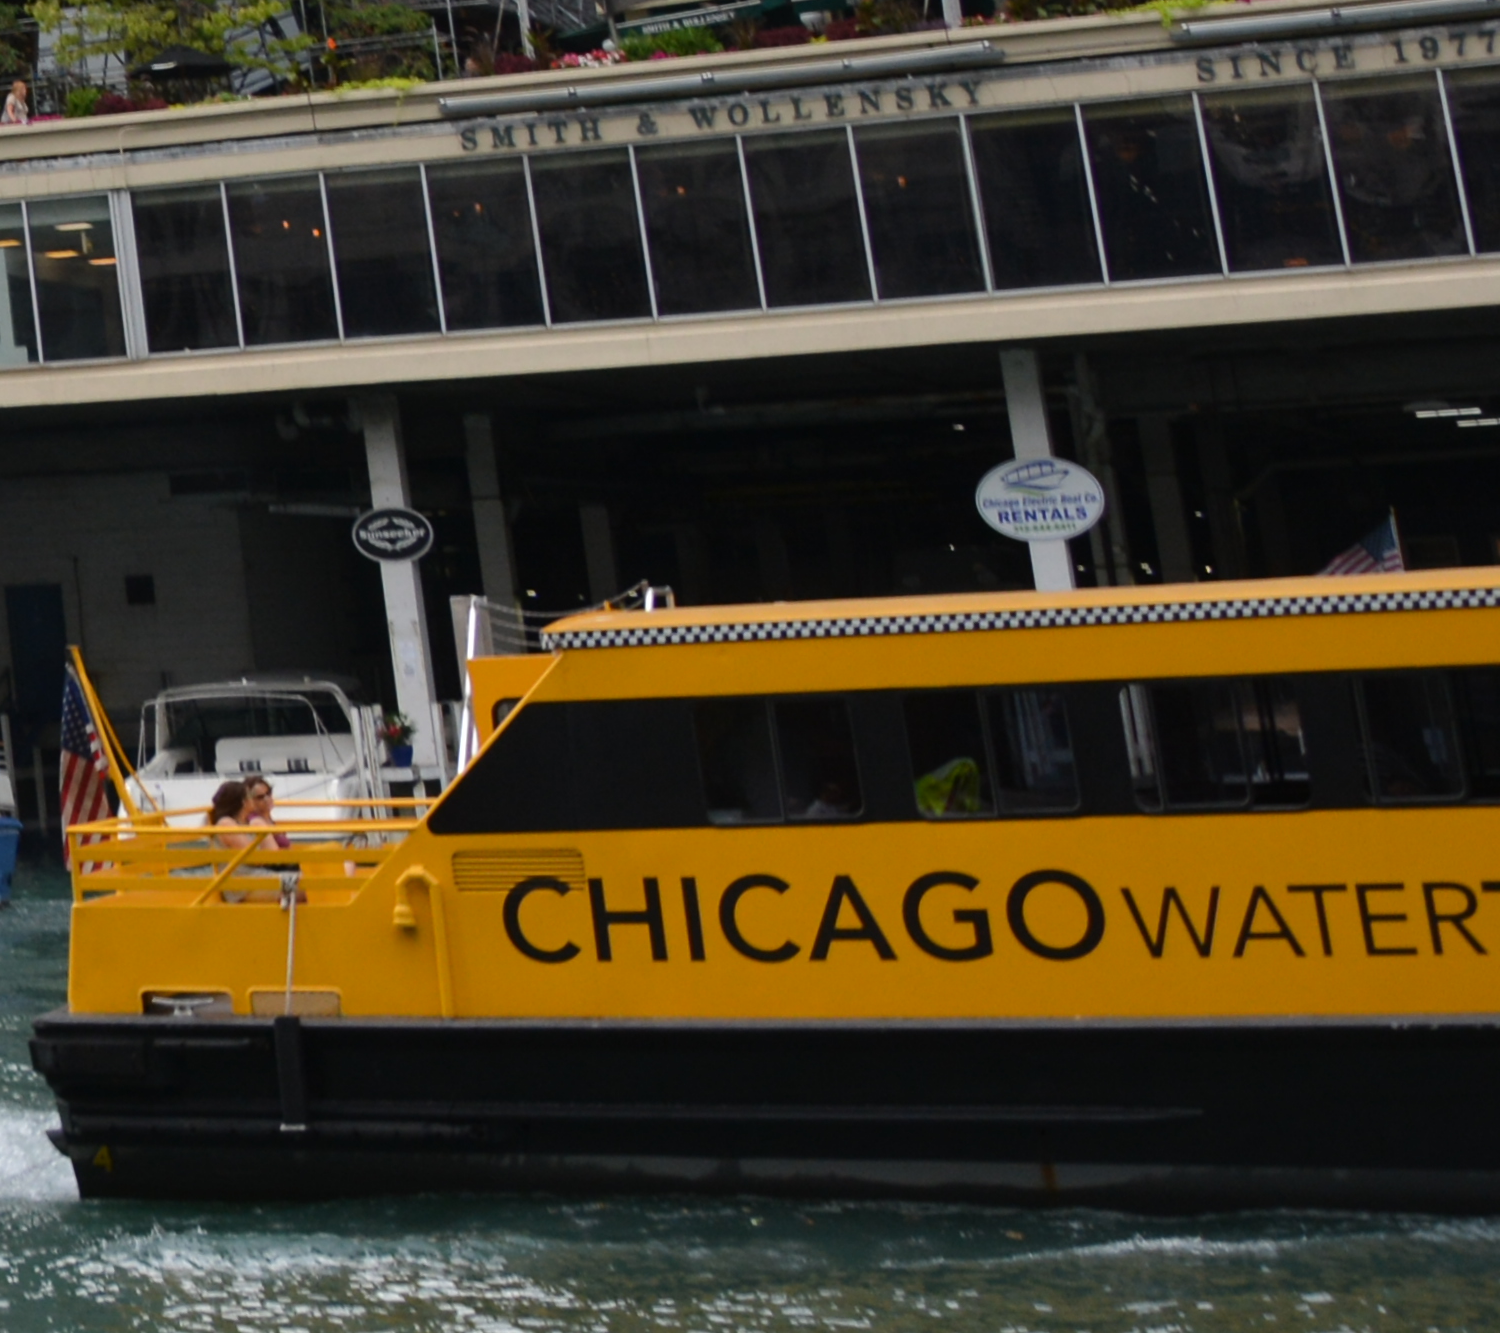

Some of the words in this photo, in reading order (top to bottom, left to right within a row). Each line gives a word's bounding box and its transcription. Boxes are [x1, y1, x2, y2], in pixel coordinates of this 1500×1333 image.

[1196, 44, 1355, 82] SINCE
[1393, 30, 1497, 63] 1977
[461, 117, 603, 152] SMITH
[637, 111, 659, 135] &
[688, 79, 983, 130] WOLLENSKY
[998, 507, 1088, 524] RENTALS
[501, 868, 1106, 964] CHICAGO
